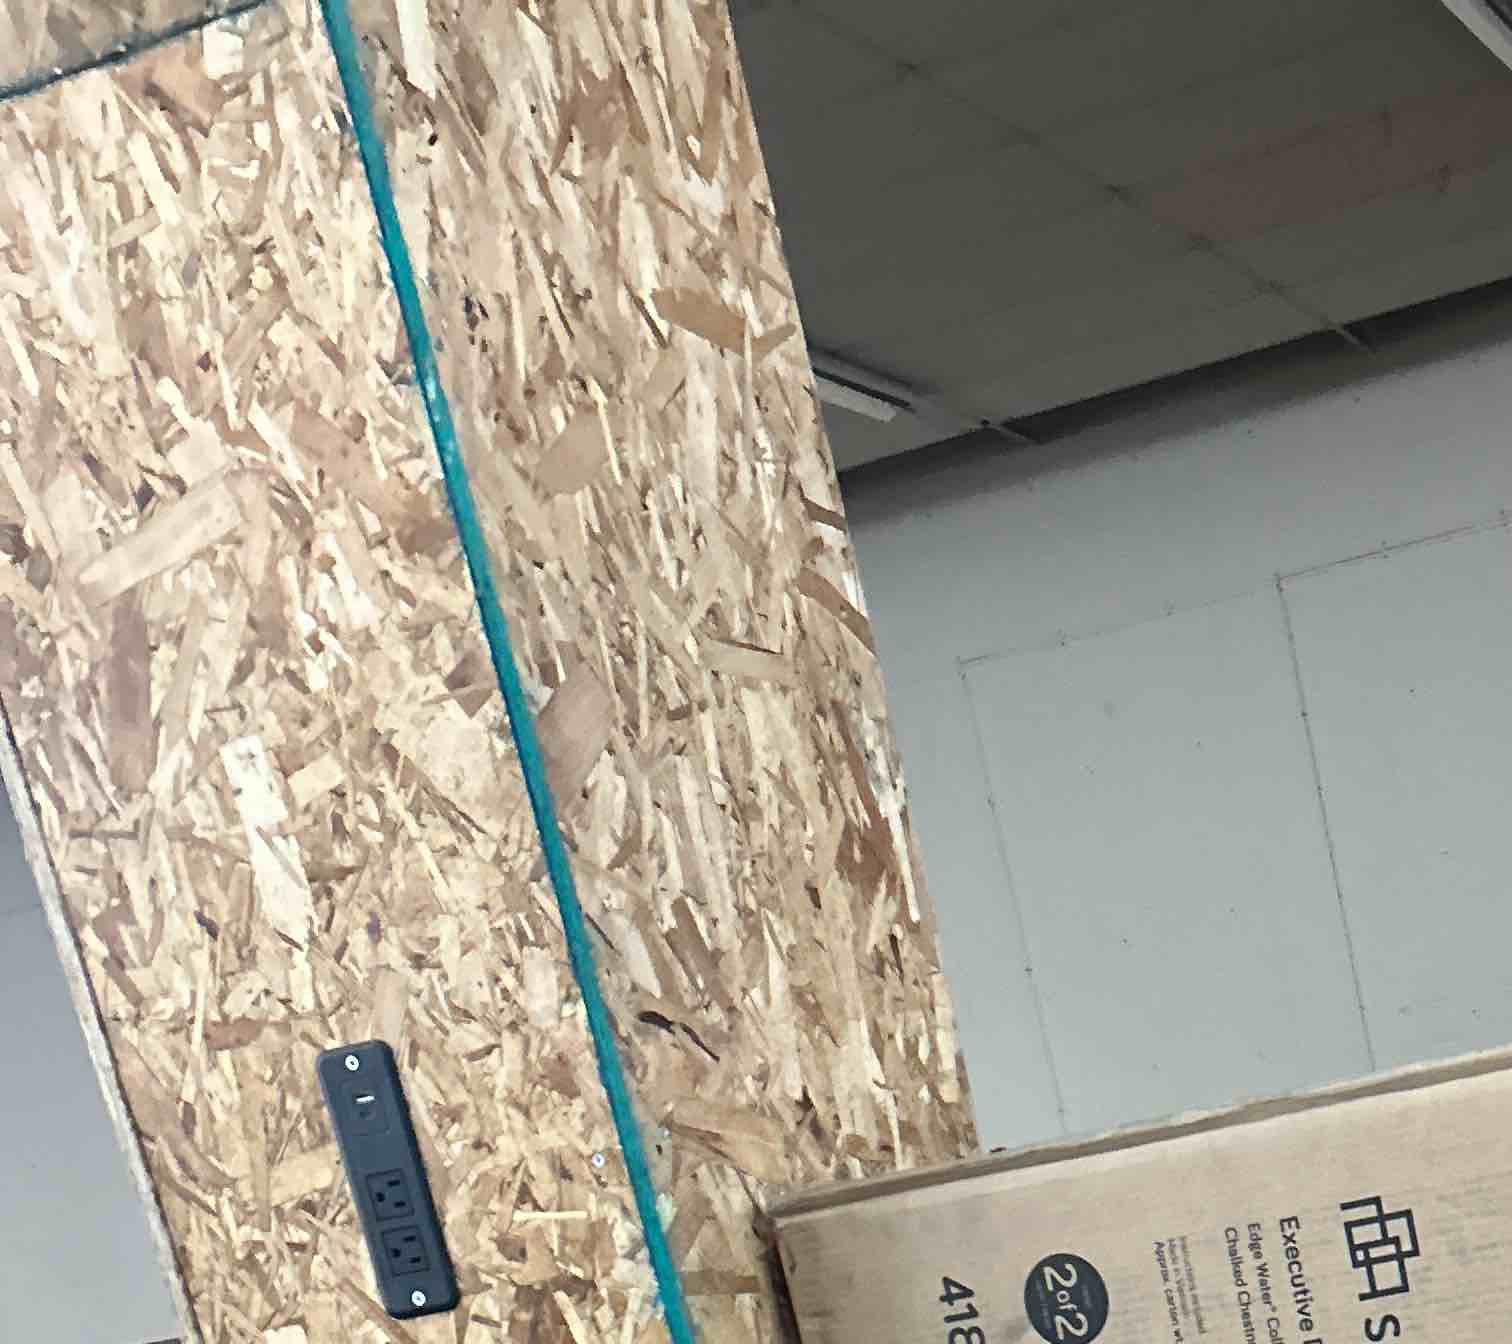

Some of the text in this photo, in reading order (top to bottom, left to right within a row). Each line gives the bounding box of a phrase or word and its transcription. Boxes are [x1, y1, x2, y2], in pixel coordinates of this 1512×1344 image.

[1225, 1227, 1247, 1287] Chalked
[1248, 1222, 1263, 1259] Edge
[1280, 1216, 1313, 1331] Executive
[1164, 1288, 1179, 1326] carton
